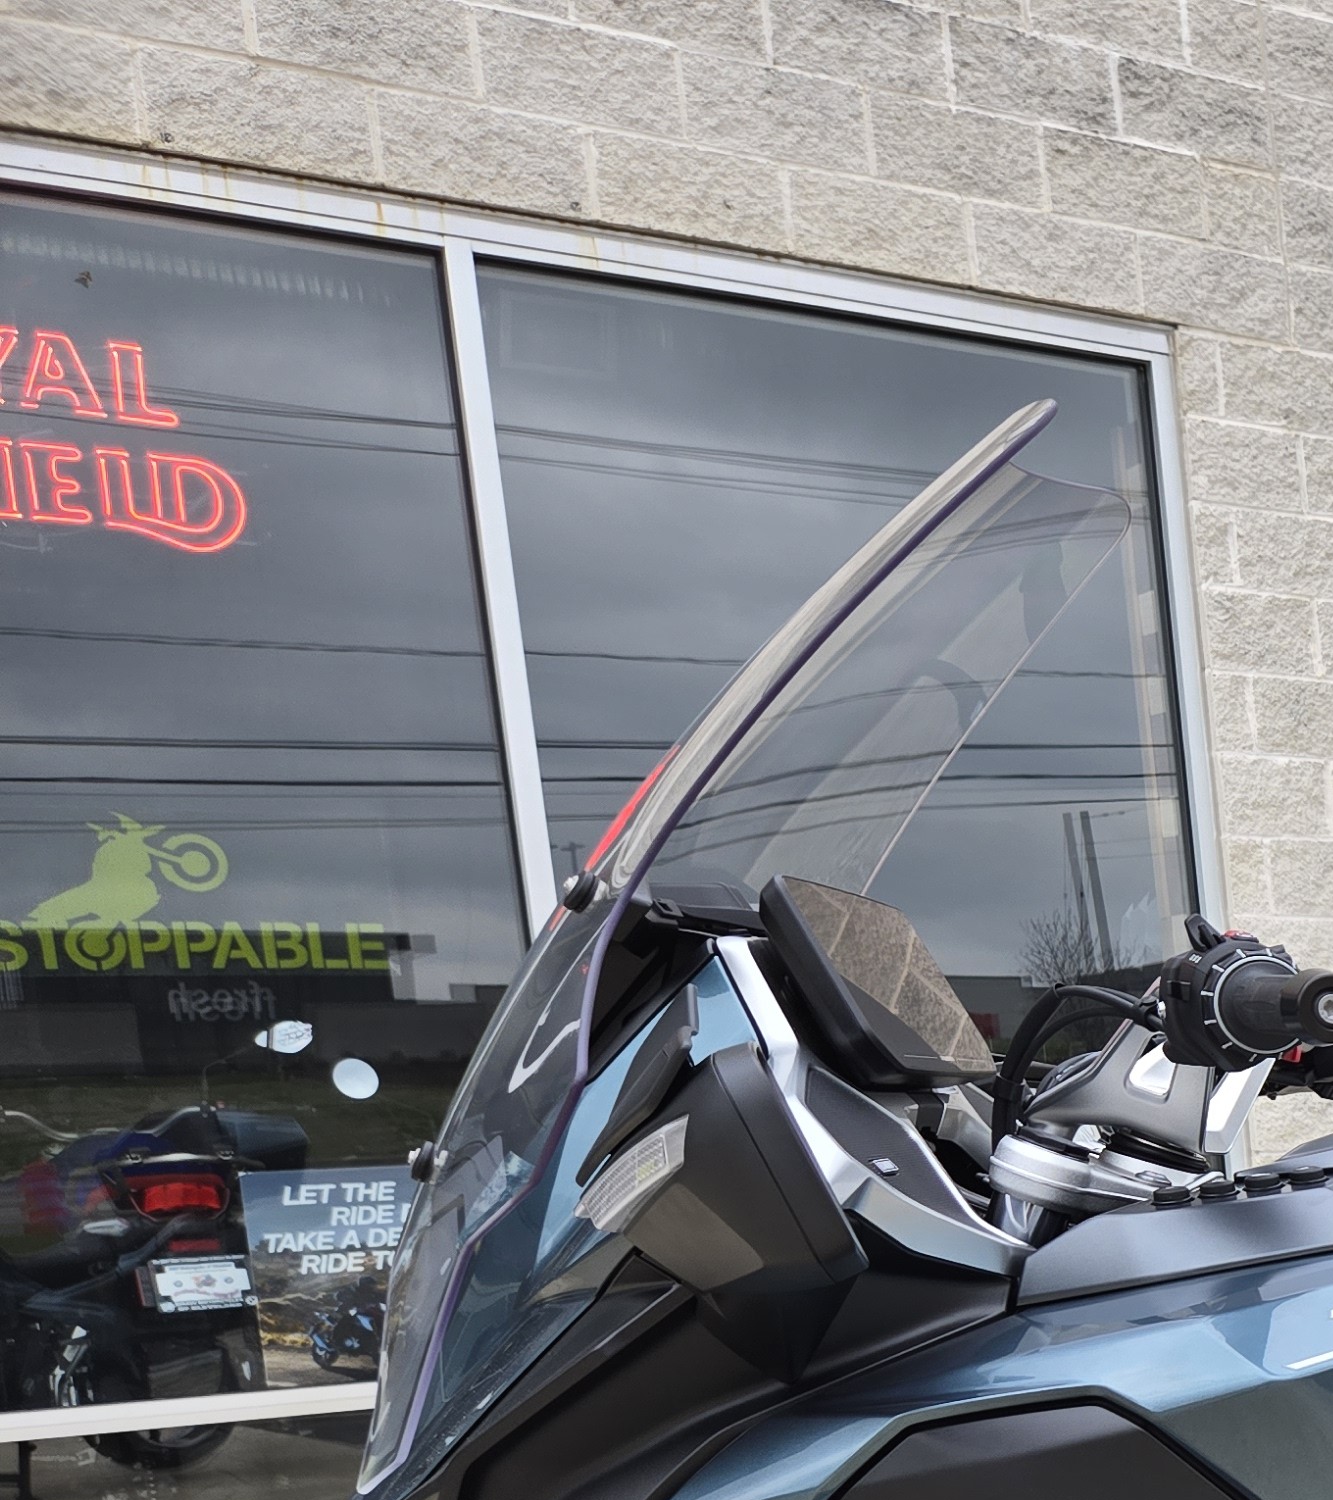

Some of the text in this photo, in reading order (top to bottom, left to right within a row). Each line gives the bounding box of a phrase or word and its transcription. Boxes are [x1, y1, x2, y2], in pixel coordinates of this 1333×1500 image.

[283, 1181, 396, 1206] LET THE
[331, 1204, 395, 1226] RIDE
[264, 1227, 403, 1253] TAKE A DE
[300, 1252, 365, 1275] RIDE
